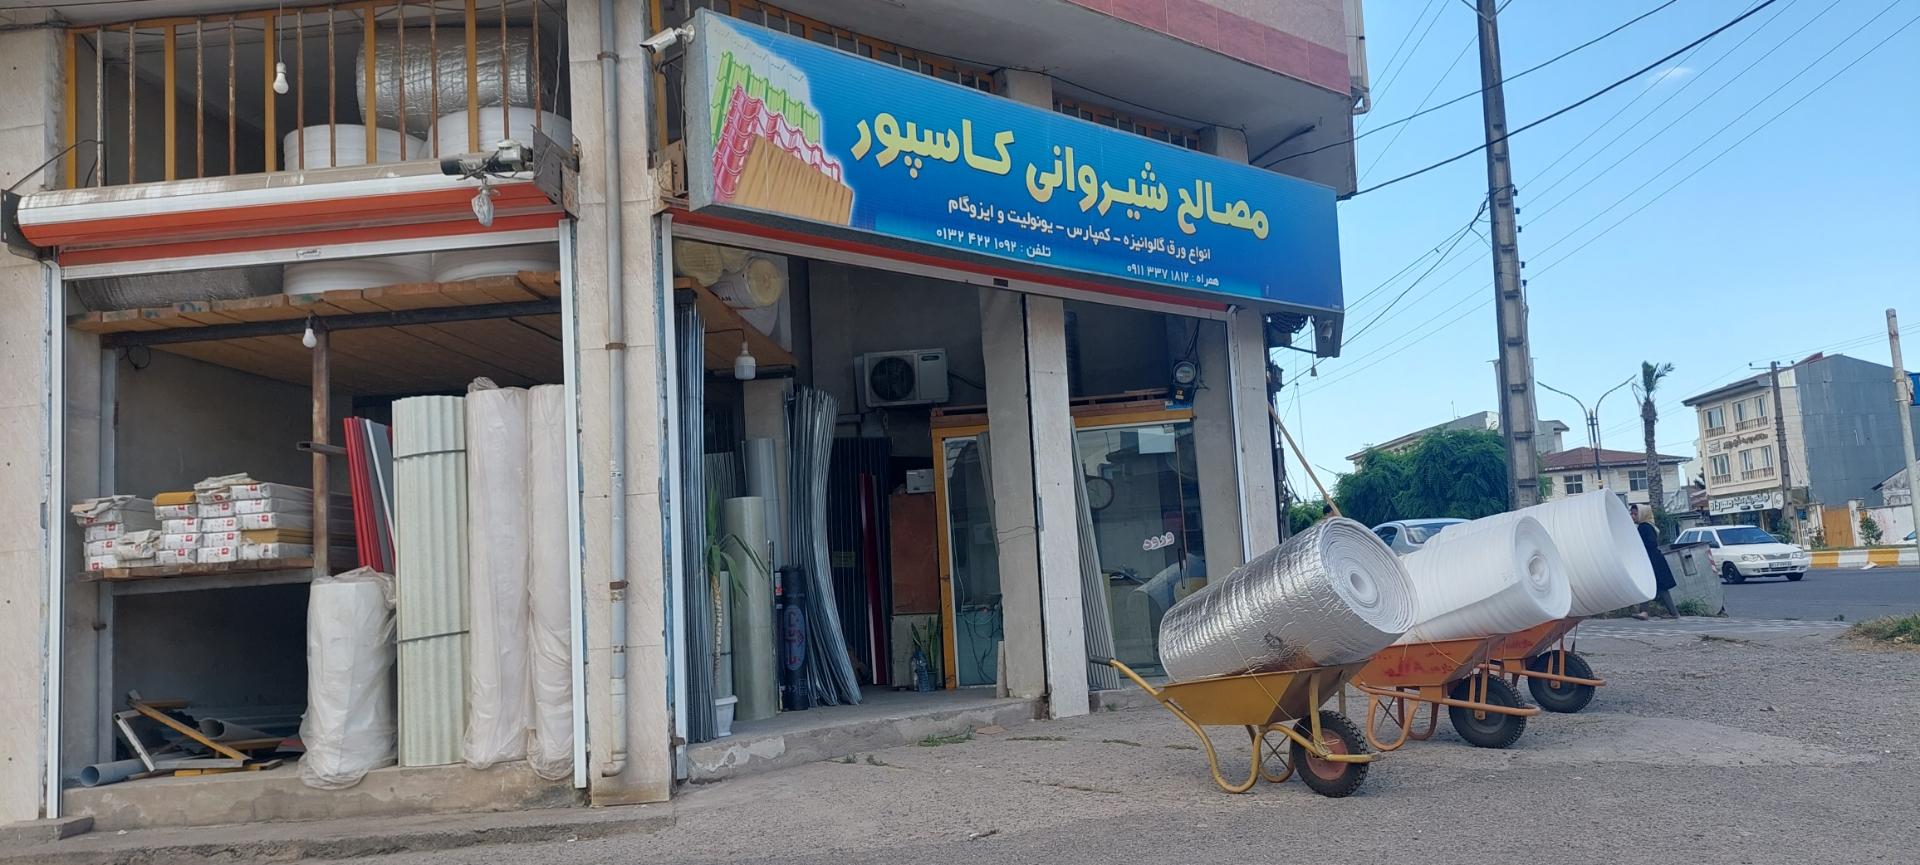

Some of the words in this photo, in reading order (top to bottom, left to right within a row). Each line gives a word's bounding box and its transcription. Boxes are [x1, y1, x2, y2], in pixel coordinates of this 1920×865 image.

[851, 112, 1015, 178] کاسپور
[1026, 145, 1168, 220] شیروانی
[948, 196, 994, 221] ایزوگام
[997, 209, 1005, 223] و
[1177, 179, 1269, 239] مصالح
[1007, 210, 1053, 233] یونولیت
[1067, 225, 1111, 245] کمپارس
[1124, 234, 1165, 253] گالوانیزه
[1026, 243, 1051, 257] تلفن
[1167, 240, 1186, 259] ورق
[1188, 246, 1211, 264] انواع
[1196, 274, 1220, 287] همراه
[1143, 532, 1175, 550] ورود
